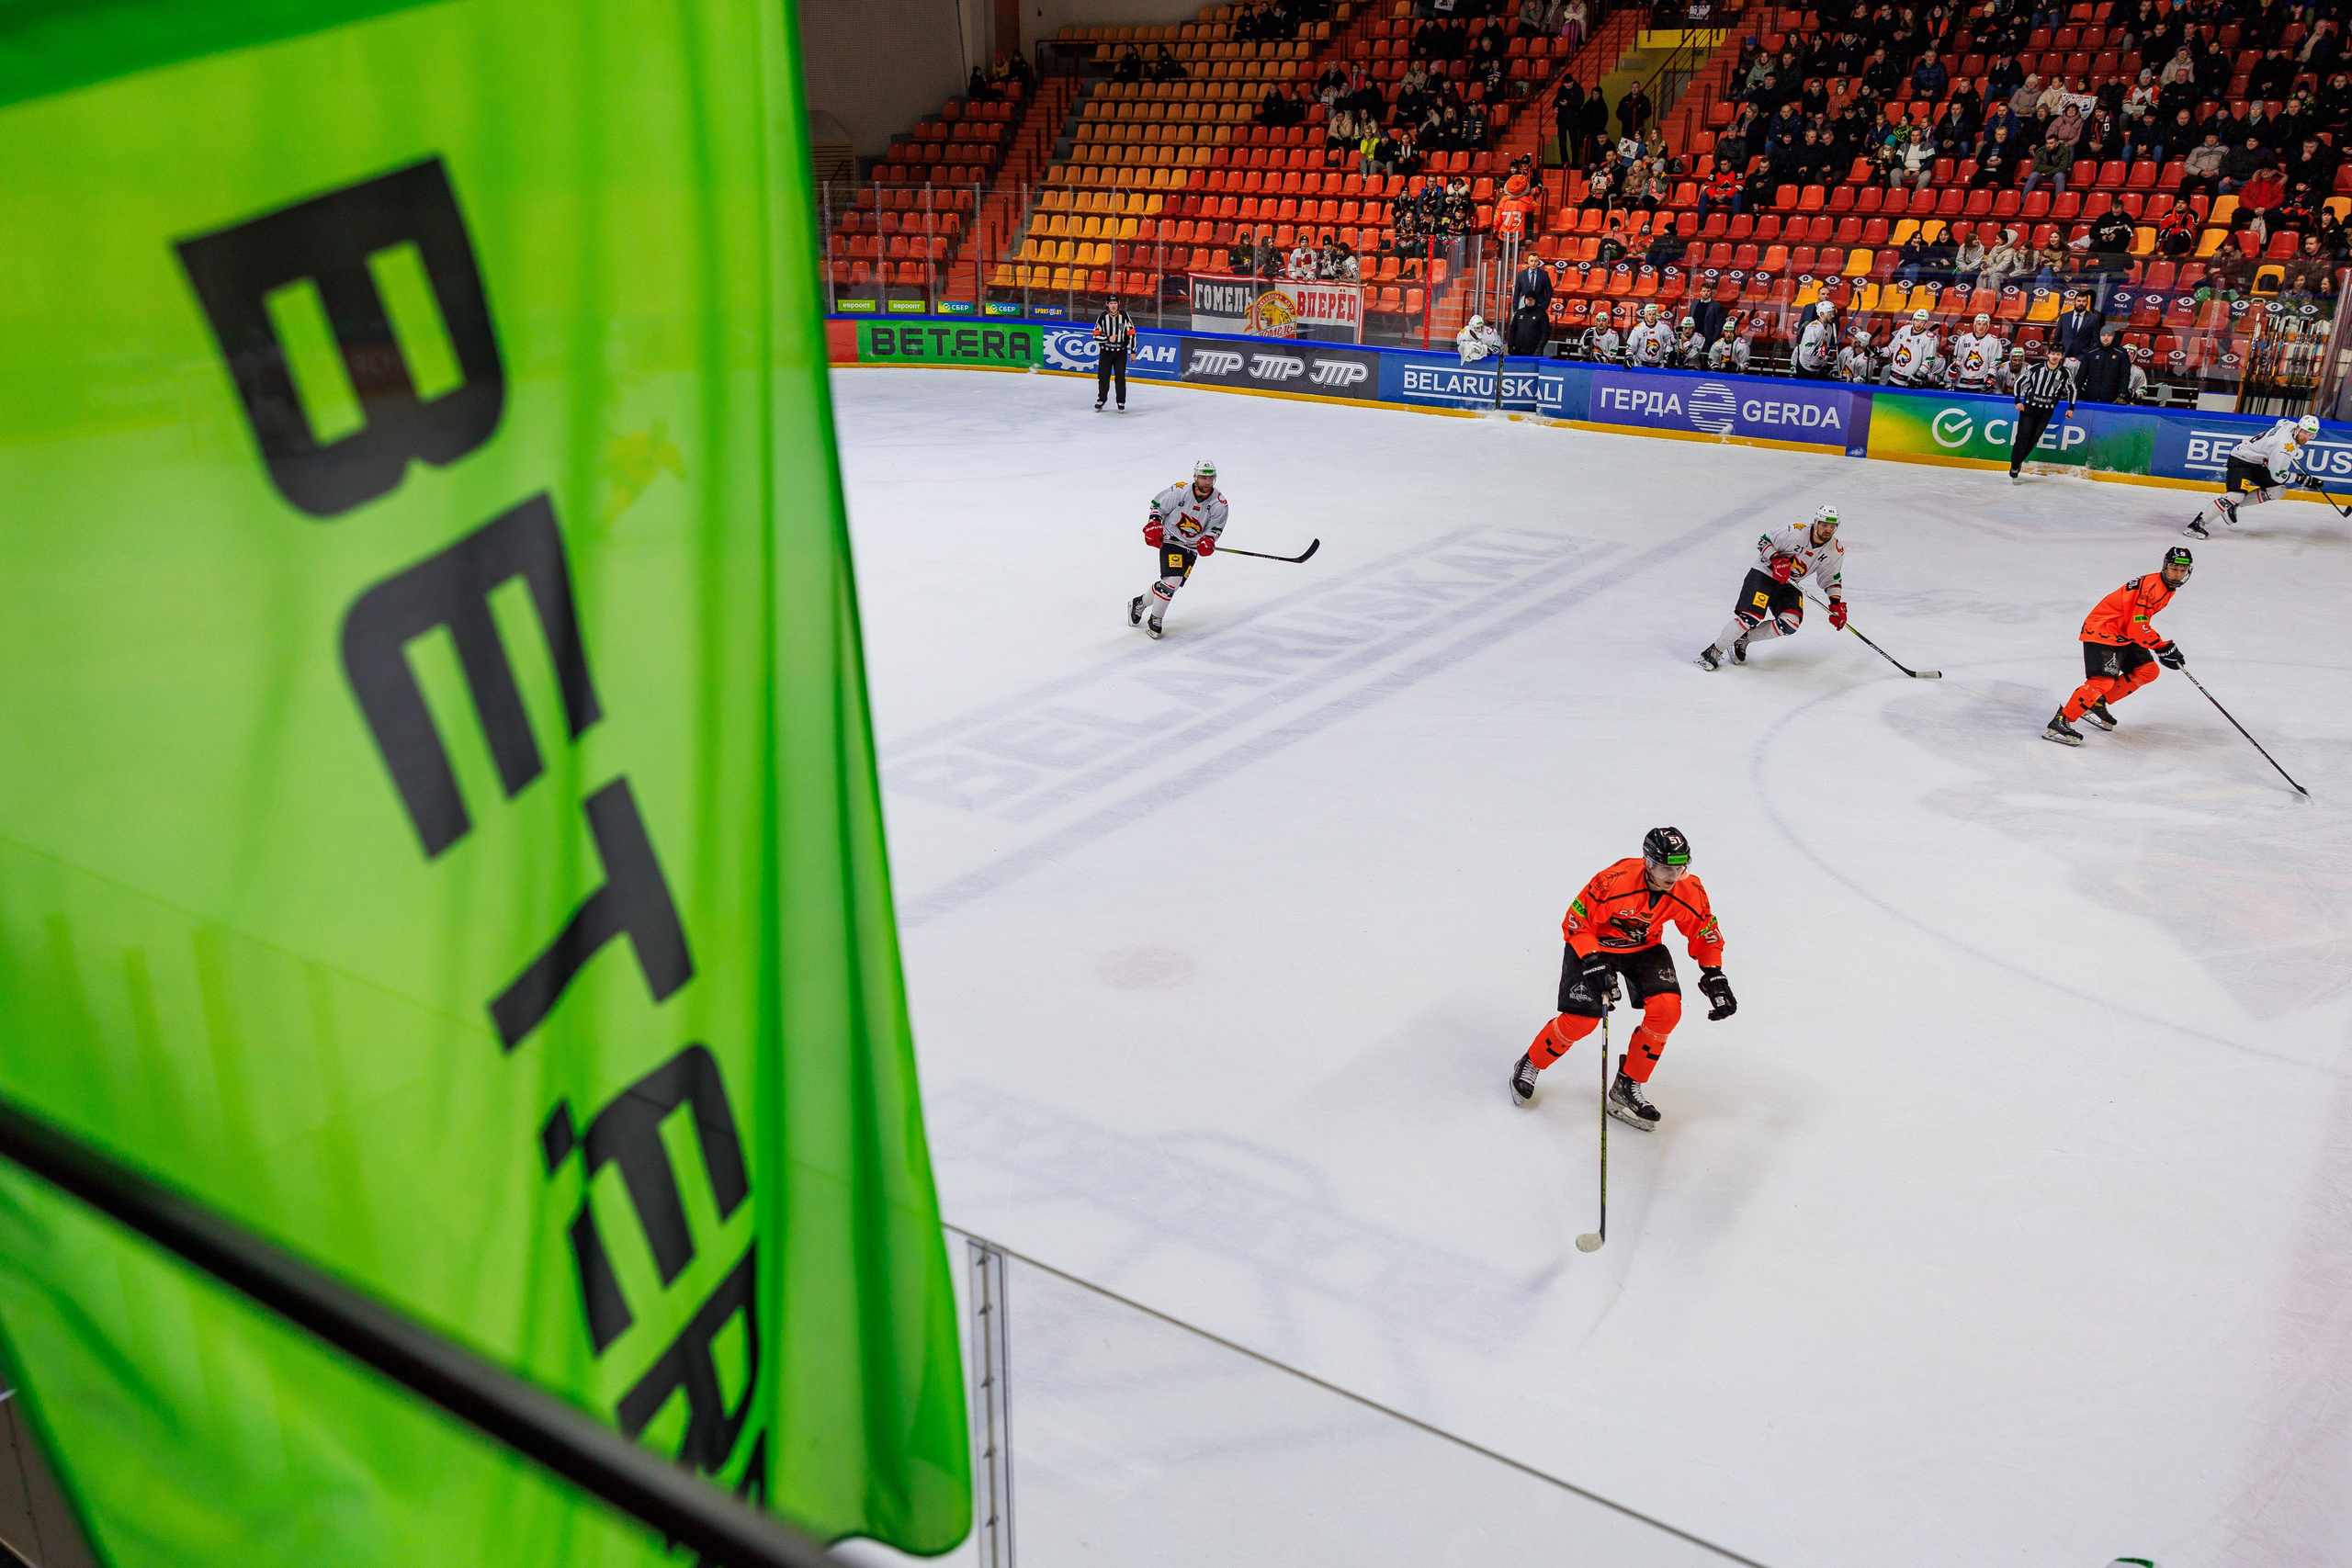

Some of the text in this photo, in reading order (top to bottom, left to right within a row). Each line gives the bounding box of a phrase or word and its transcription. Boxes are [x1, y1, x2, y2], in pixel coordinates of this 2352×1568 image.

[1501, 211, 1522, 227] 73
[1195, 283, 1358, 322] ГОМЕЛЬ ВПЕРЁД
[871, 327, 1032, 360] BET.ERA
[1600, 387, 1682, 418] ГЕРДА
[1742, 399, 1841, 430] GERDA
[2187, 438, 2352, 474] BERUS
[1668, 836, 1682, 844] 51
[1703, 928, 1723, 944] 51
